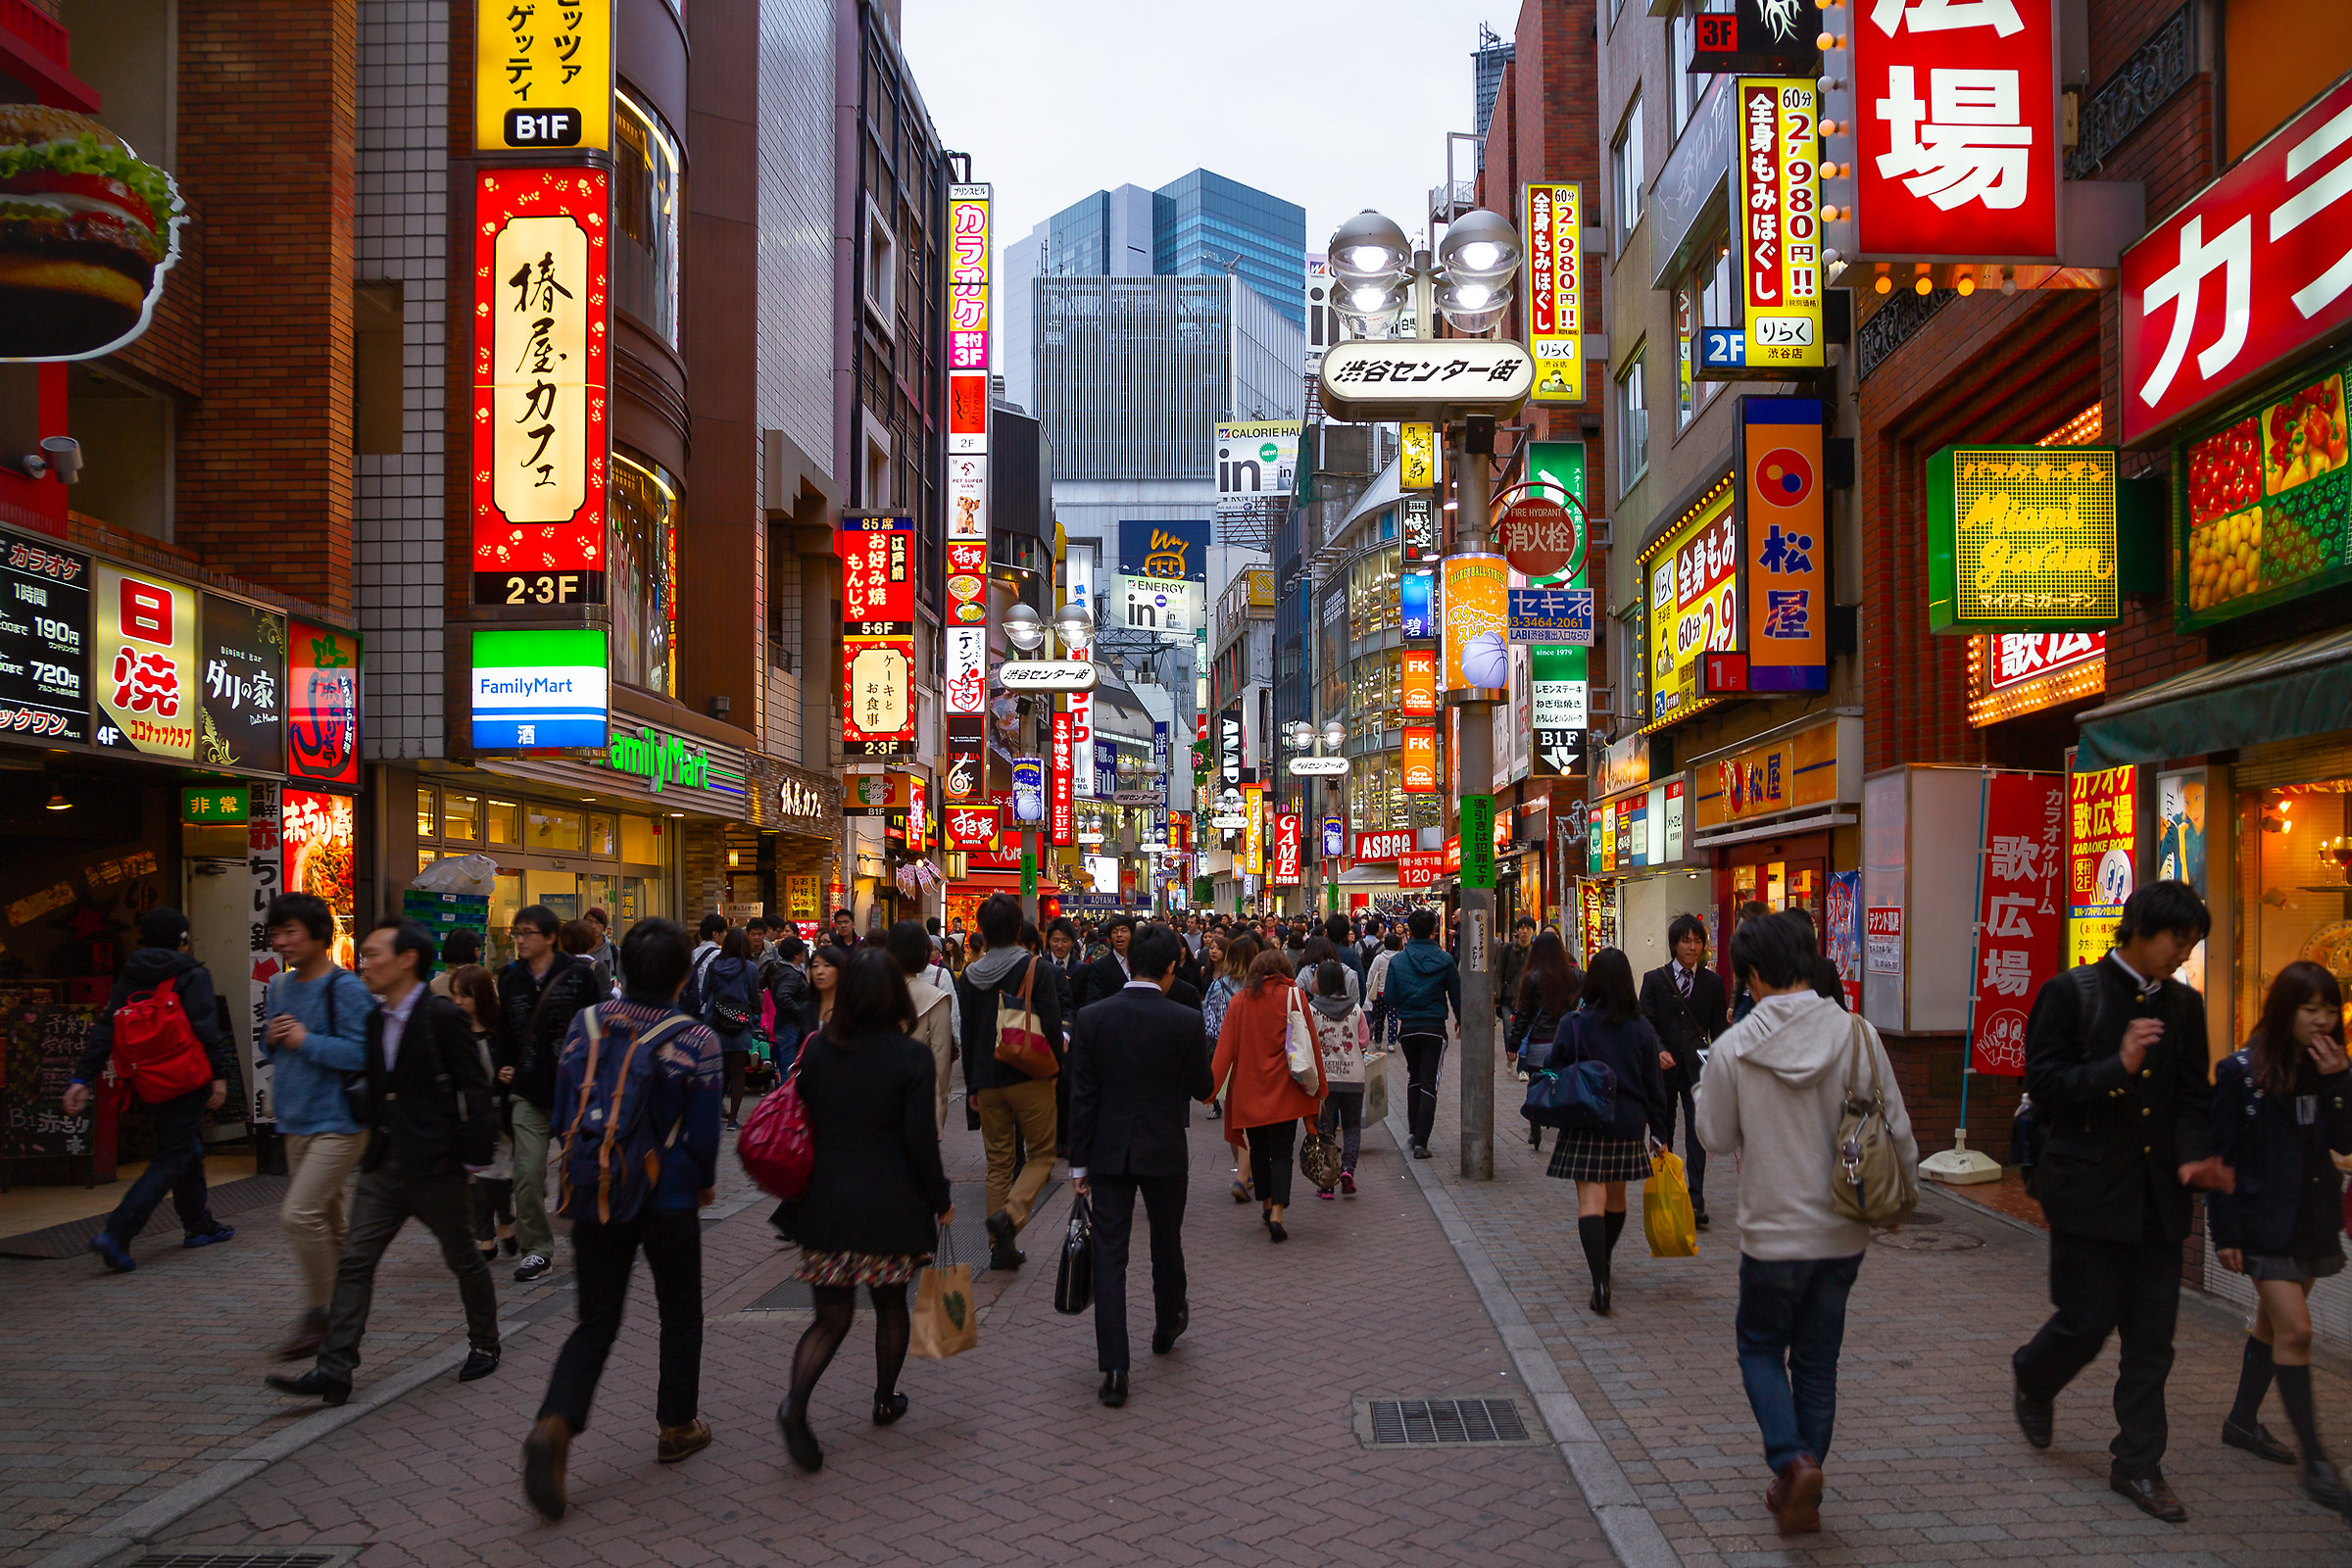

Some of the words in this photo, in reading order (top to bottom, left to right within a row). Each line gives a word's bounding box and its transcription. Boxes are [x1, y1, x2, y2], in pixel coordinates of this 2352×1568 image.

[1703, 20, 1733, 47] 3F
[1782, 87, 1813, 109] 60分
[515, 115, 569, 139] B1F
[1554, 188, 1575, 204] 60分
[1748, 92, 1778, 301] 全身もみほぐし
[954, 203, 986, 329] カラオケ
[1532, 191, 1552, 331] 全身もみほぐし
[1763, 320, 1809, 343] りらく
[955, 348, 984, 366] 3F
[1540, 343, 1573, 359] りらく
[1708, 334, 1744, 364] 2F
[1767, 347, 1803, 361] 渋谷店
[508, 253, 573, 487] 椿屋カフェ
[1334, 359, 1523, 384] 渋谷センター街
[960, 438, 975, 448] 2F
[1232, 428, 1279, 438] CALORIE
[1219, 448, 1261, 492] in
[1279, 466, 1292, 478] in
[861, 517, 894, 531] 85席
[1511, 508, 1527, 517] FIRE
[1529, 508, 1562, 517] HYDRANT
[1962, 491, 2083, 536] Miami
[1506, 522, 1570, 553] 消火栓
[9, 543, 81, 580] カラオケ
[952, 544, 982, 566] すき家
[867, 532, 887, 606] お好み焼
[1450, 565, 1487, 587] BASKETBALL
[1758, 524, 1813, 639] 松屋
[14, 582, 48, 608] 1時間
[846, 554, 864, 619] もんじゃ
[1138, 580, 1186, 595] ENERGY
[1655, 566, 1672, 603] りらく
[1128, 593, 1156, 627] in
[1978, 592, 2098, 609] マイアミガーデン
[34, 615, 80, 646] 190円
[113, 577, 180, 718] 日焼
[2000, 630, 2106, 677] 歌広
[29, 660, 80, 689] 720円
[1408, 660, 1431, 672] FK
[205, 659, 275, 710] ダリの家
[480, 678, 572, 697] FamilyMart
[1535, 684, 1584, 695] レモンステーキ
[865, 682, 880, 727] お食事
[97, 725, 119, 745] 4F
[130, 720, 192, 749] ココナッツクラブ
[516, 724, 535, 745] 酒
[1408, 737, 1431, 750] FK
[1541, 731, 1579, 746] B1F
[599, 726, 709, 793] amilyMart
[1094, 745, 1114, 764] 服の
[1222, 718, 1240, 783] ANAP
[190, 797, 239, 814] 非常
[1054, 805, 1069, 814] 2F
[2073, 794, 2133, 841] 歌広場
[951, 808, 994, 840] すき家
[1054, 817, 1069, 827] 3F
[1054, 830, 1069, 840] 4F
[1277, 814, 1298, 875] GAME
[1361, 834, 1411, 859] ASBee
[1474, 799, 1488, 884] 客引きは犯罪です
[2072, 840, 2108, 857] KARAOKE
[2108, 837, 2134, 853] ROOM
[2038, 788, 2064, 915] カラオケルーム
[2076, 858, 2092, 875] 受付
[2077, 877, 2091, 890] 2F
[1090, 896, 1117, 905] AOYAMA
[1983, 835, 2040, 998] 歌広場
